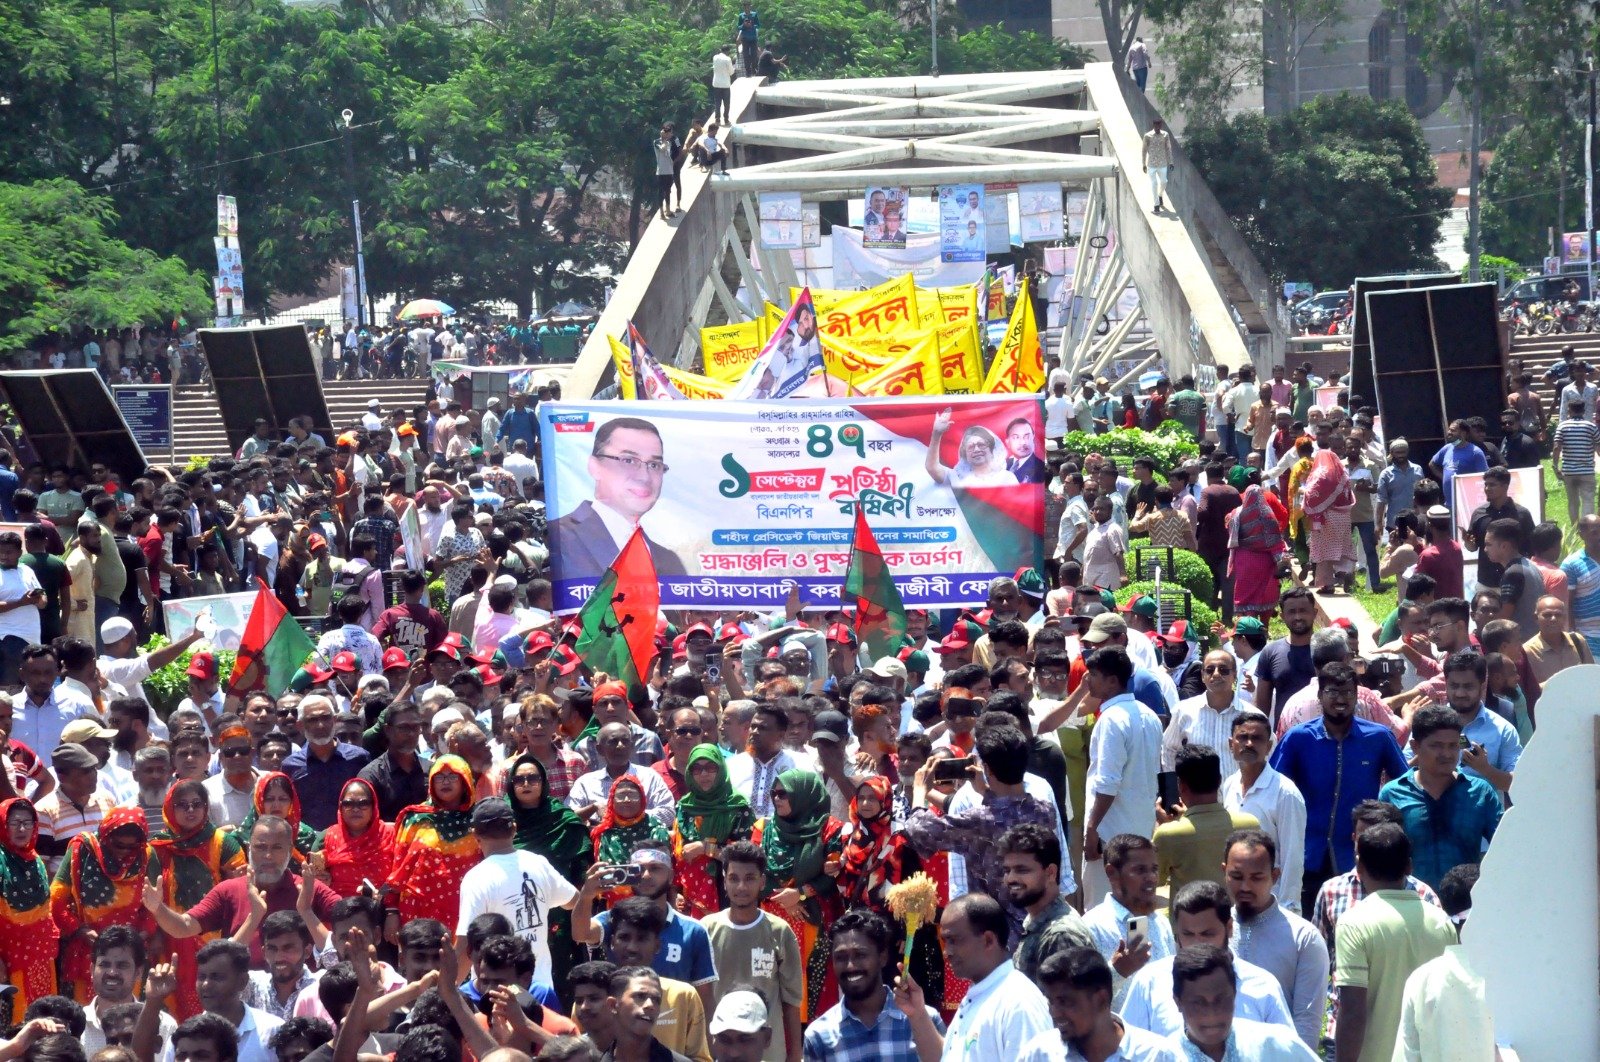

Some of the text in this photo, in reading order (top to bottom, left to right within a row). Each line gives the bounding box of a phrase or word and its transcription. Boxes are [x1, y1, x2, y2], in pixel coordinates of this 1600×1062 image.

[856, 296, 910, 332] দল
[806, 424, 892, 458] ৪৭ বছর
[718, 453, 817, 499] ১ সেপ্টেম্বর
[720, 532, 749, 543] শহীদ
[753, 531, 802, 543] প্রেসিডেন্ট
[807, 530, 848, 542] জিয়াউর
[903, 530, 950, 540] সমাধিতে
[700, 549, 788, 572] শ্রদ্ধাঞ্জলি
[792, 554, 808, 568] ও
[909, 546, 963, 566] অর্পণ
[665, 943, 682, 963] B
